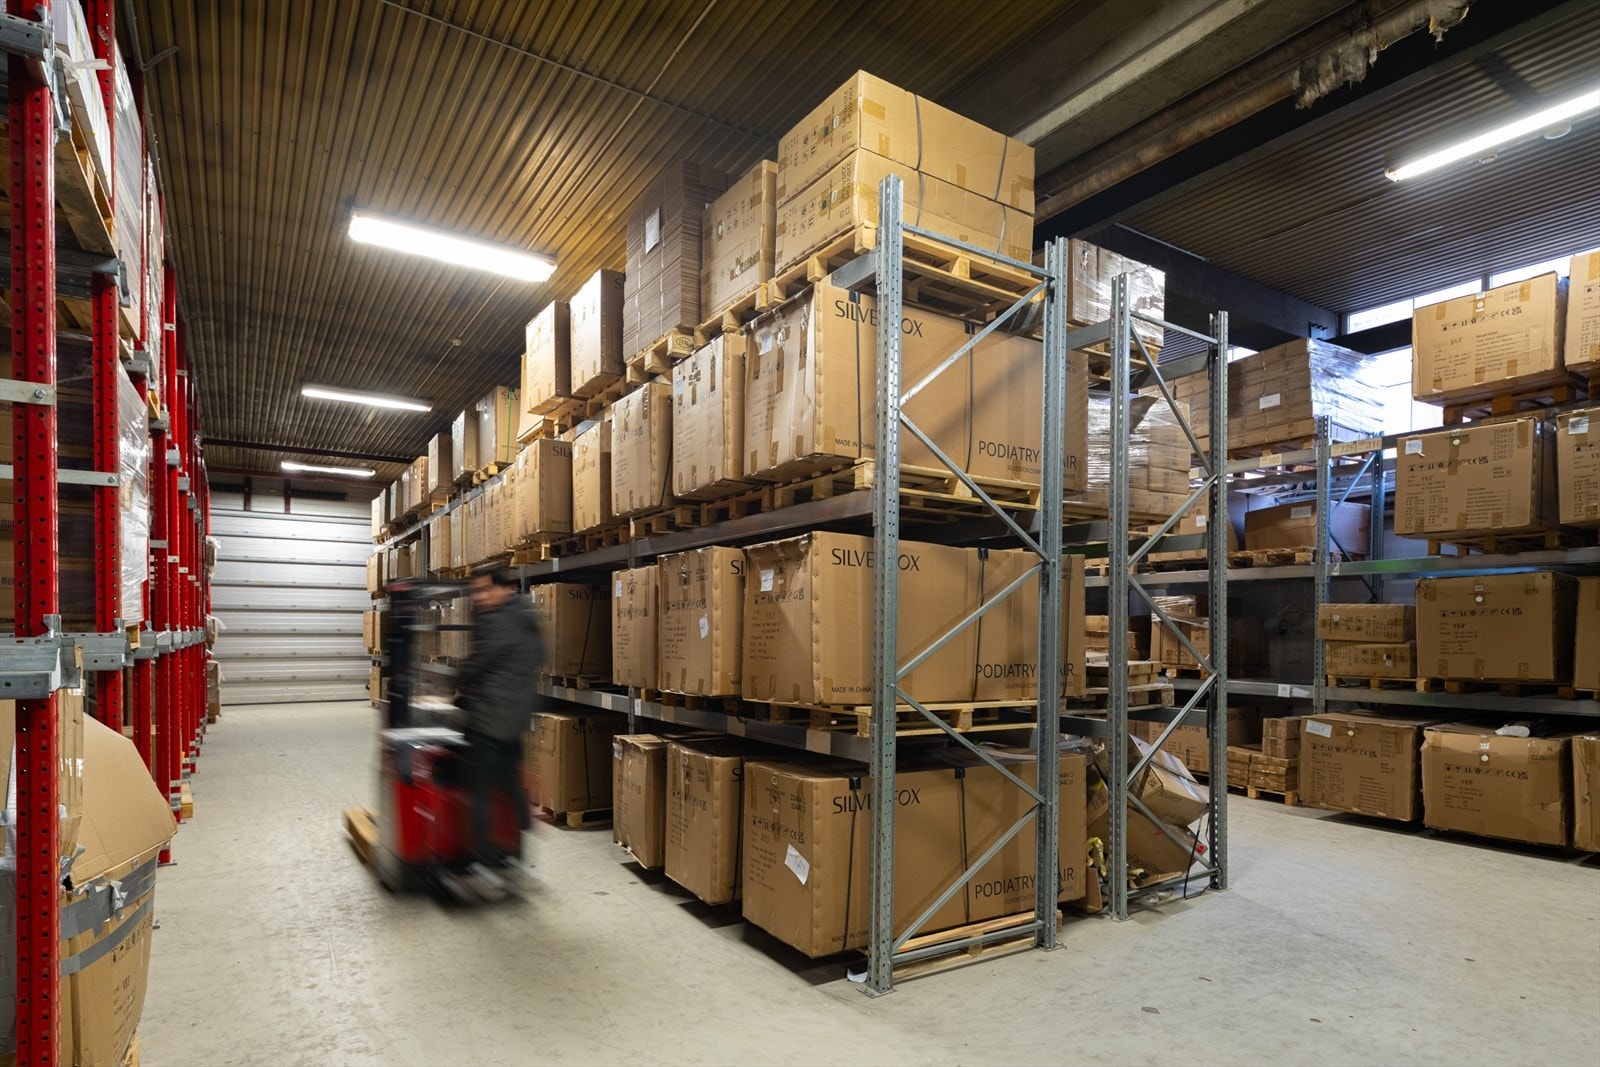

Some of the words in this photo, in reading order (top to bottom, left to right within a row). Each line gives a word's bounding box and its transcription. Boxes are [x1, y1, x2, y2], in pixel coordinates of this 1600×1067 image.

[835, 300, 923, 338] SILVEOX
[835, 438, 850, 446] MADE
[978, 440, 1040, 464] PODIATRY
[832, 548, 920, 572] SILVEOX
[976, 664, 1036, 678] PODIATRY
[976, 874, 1035, 900] PODIATRY
